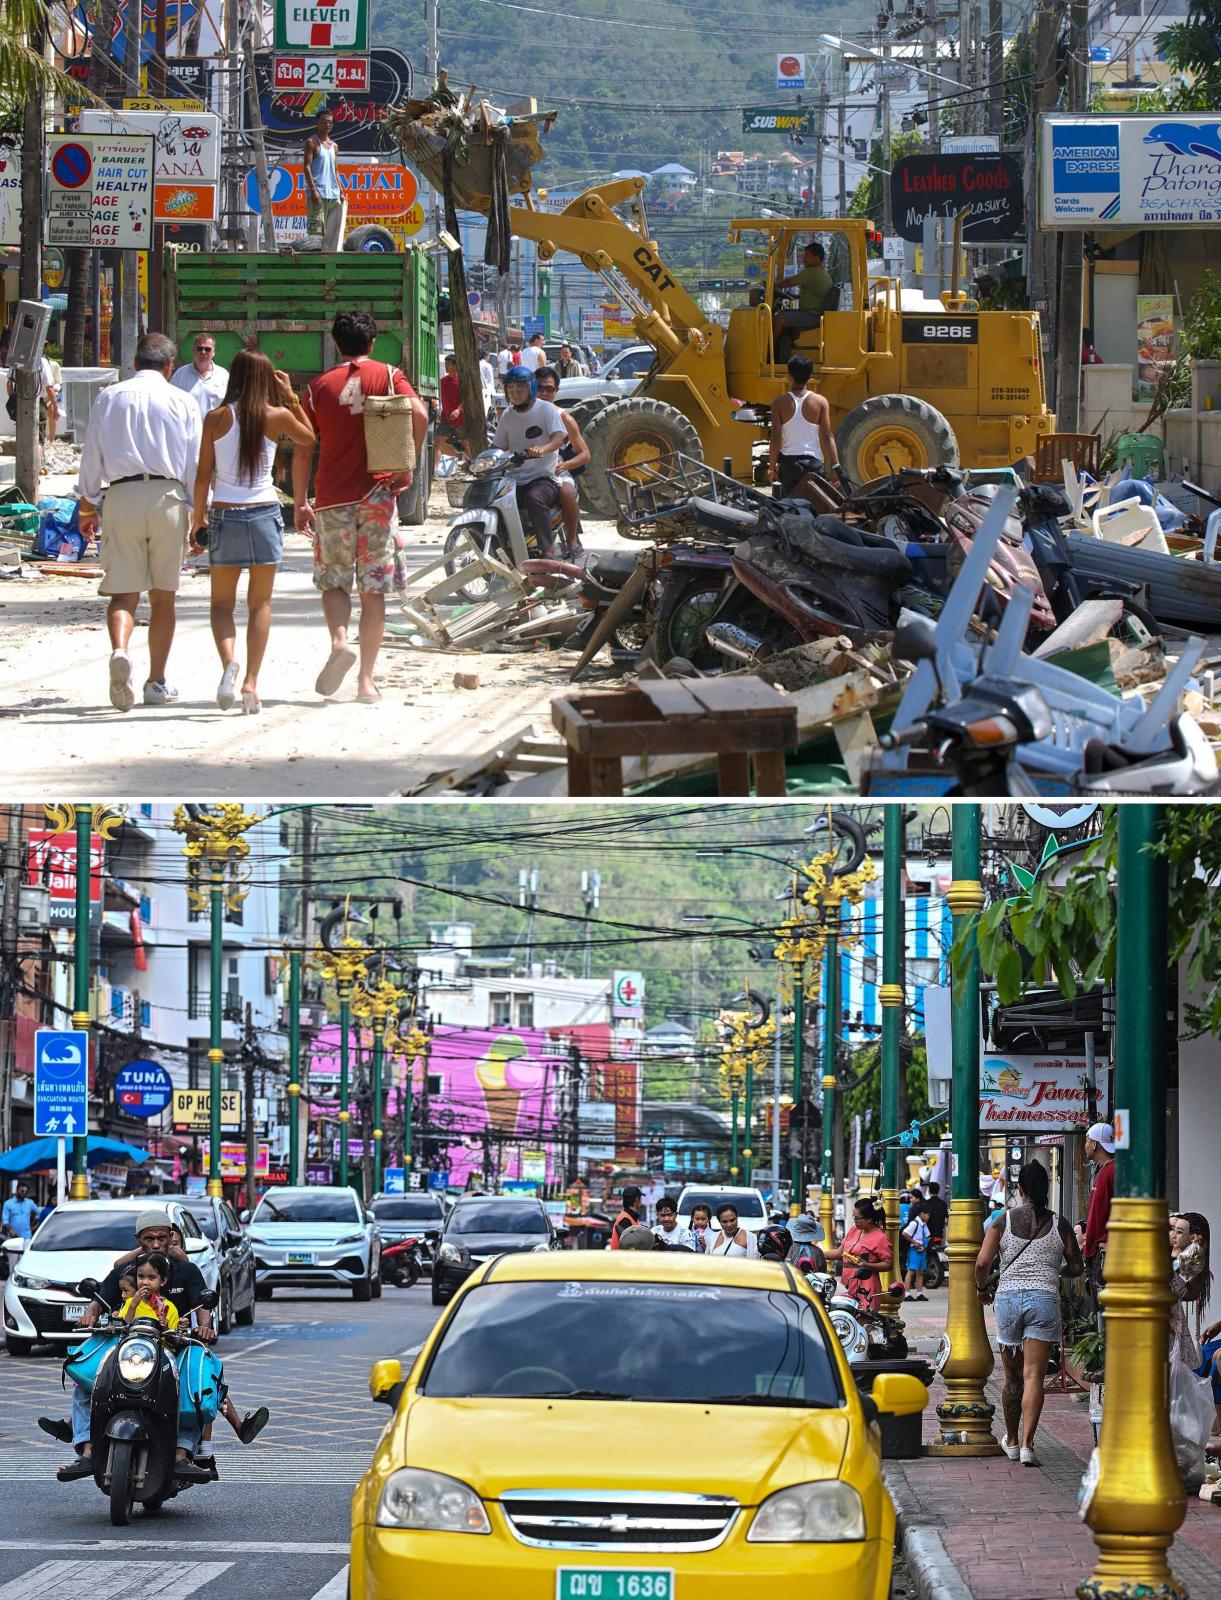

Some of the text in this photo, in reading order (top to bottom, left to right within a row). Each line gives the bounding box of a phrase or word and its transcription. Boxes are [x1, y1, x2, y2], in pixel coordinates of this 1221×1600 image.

[277, 62, 303, 79] เปิด
[306, 63, 334, 84] 24
[1053, 147, 1115, 159] AMERICAN
[101, 156, 146, 164] BARBER
[1149, 153, 1221, 176] Thara
[1067, 161, 1120, 173] EXPRESS
[97, 168, 149, 179] HAIR CUT
[95, 181, 148, 192] HEALTH
[1141, 175, 1221, 198] Patong
[356, 192, 405, 200] CLINIC
[1054, 197, 1080, 205] Cards
[1054, 205, 1095, 213] Welcome
[633, 246, 676, 293] CAT
[923, 325, 972, 338] 926E
[37, 1095, 85, 1103] EVACUATION ROUTE
[178, 1095, 236, 1111] GP HOSE
[616, 1574, 668, 1597] 1636
